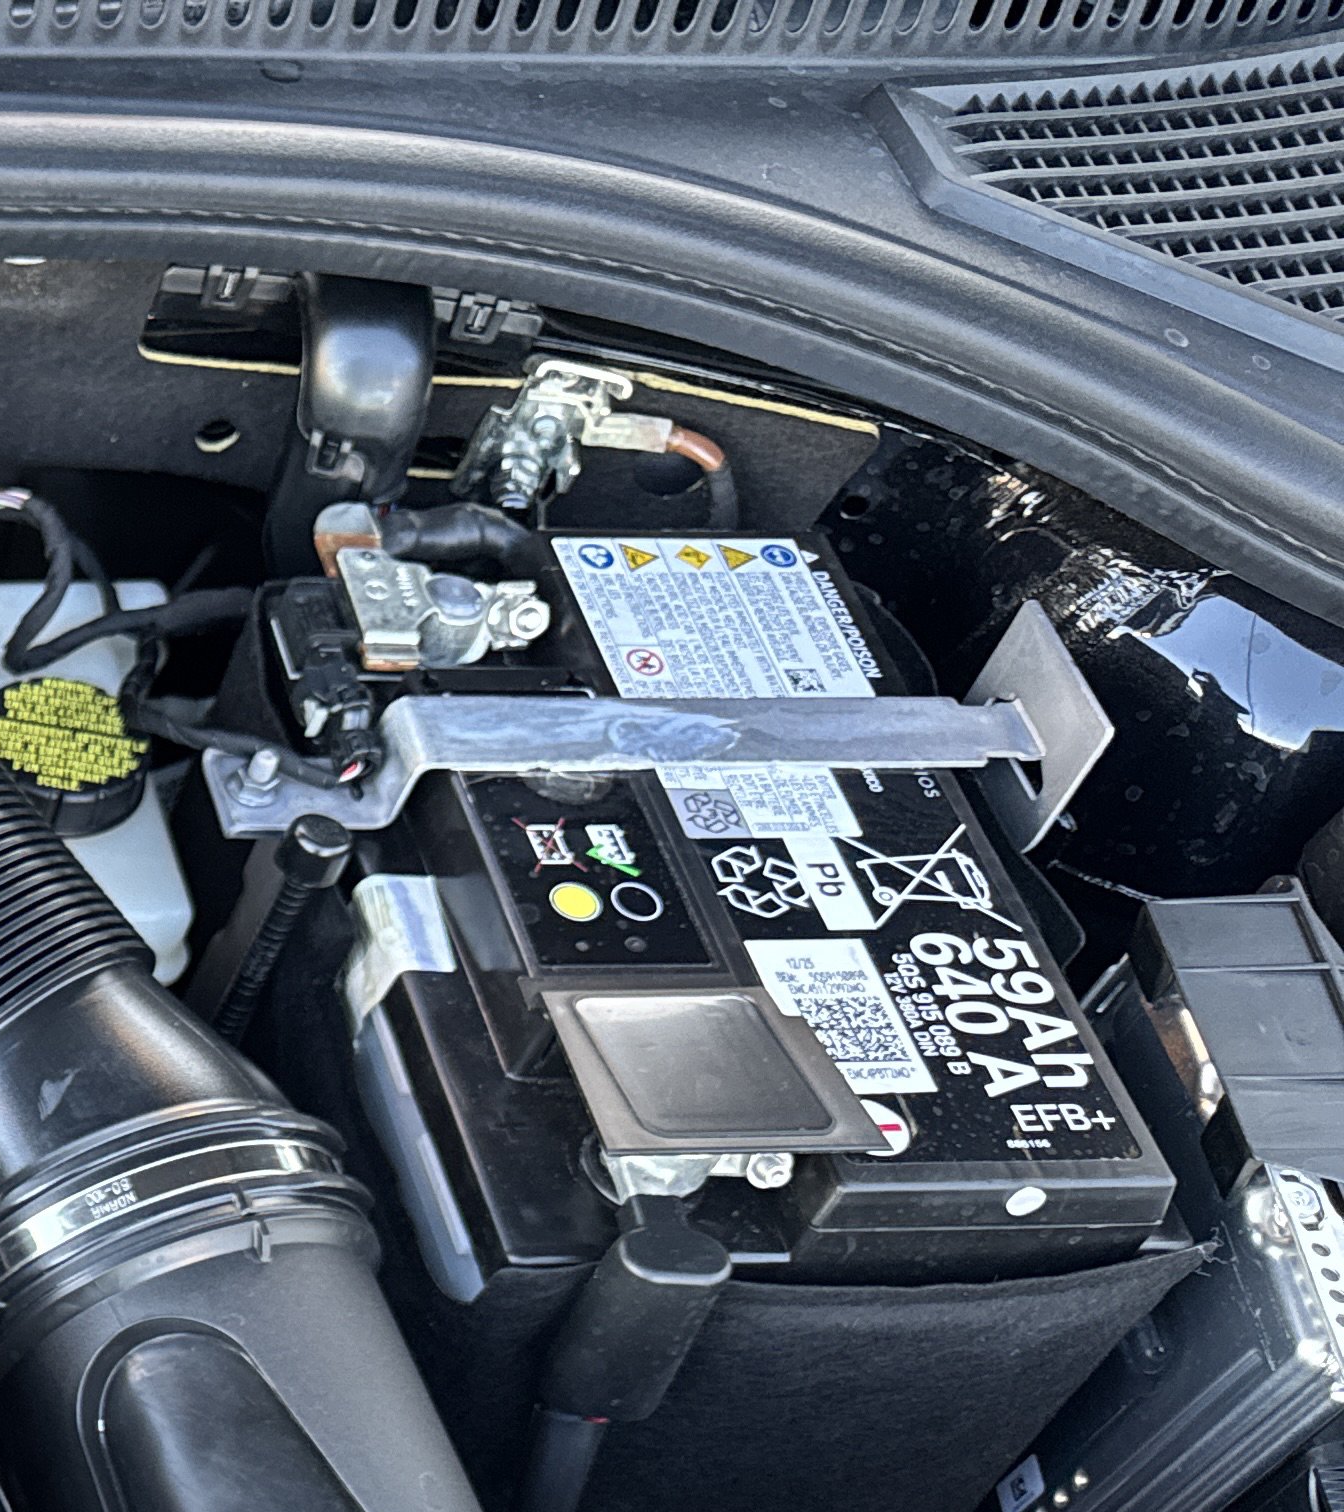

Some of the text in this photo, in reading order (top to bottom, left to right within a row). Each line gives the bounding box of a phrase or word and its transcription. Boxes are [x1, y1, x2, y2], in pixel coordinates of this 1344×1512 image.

[811, 570, 883, 679] DANGER/POISON
[807, 863, 845, 896] Pb
[884, 972, 940, 1057] 12V 380A DIN
[892, 953, 972, 1076] 5QS 915 089 B
[910, 932, 1041, 1098] 640 A
[972, 937, 1094, 1088] 59Ah
[1010, 1103, 1116, 1132] EFB+
[90, 1190, 137, 1220] NORMA
